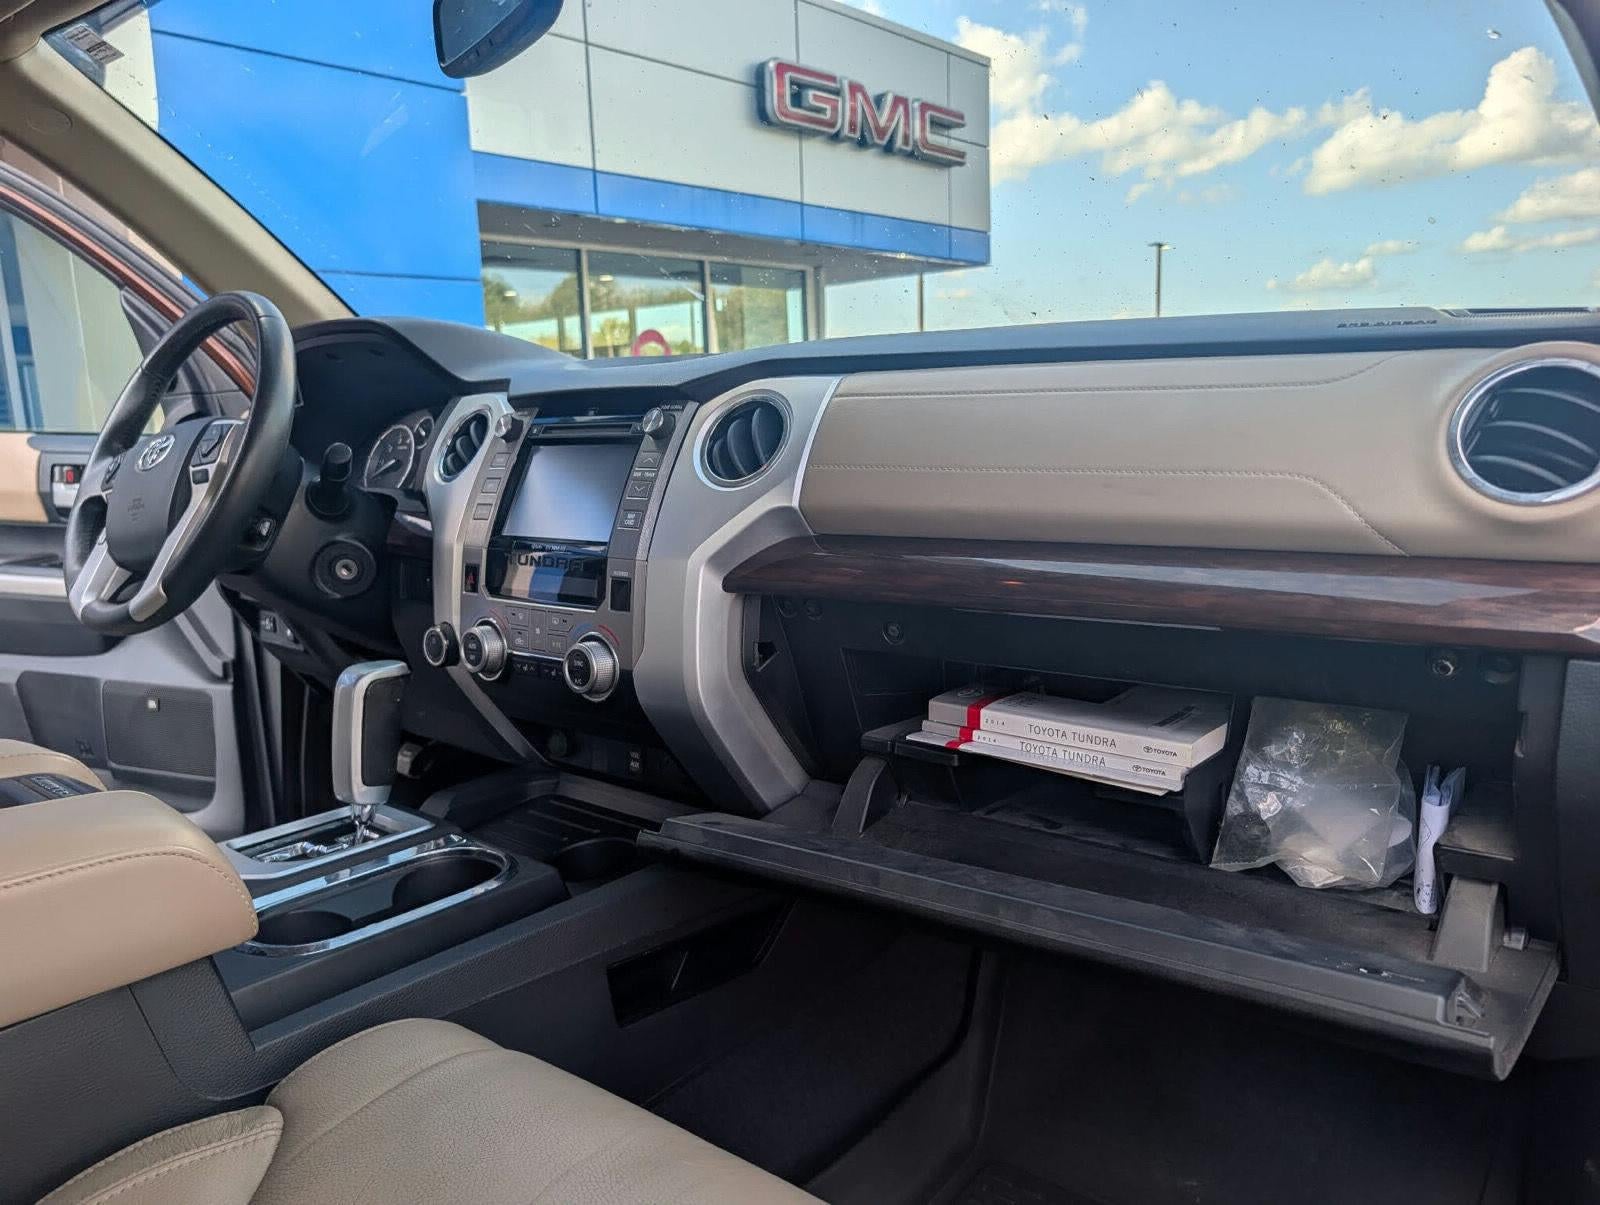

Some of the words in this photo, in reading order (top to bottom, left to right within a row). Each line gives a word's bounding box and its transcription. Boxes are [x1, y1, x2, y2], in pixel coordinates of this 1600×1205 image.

[764, 59, 967, 165] GMC
[1027, 723, 1068, 740] TOYOTA
[1072, 731, 1117, 749] TUNDRA
[1152, 748, 1178, 758] TOYOTA
[1019, 741, 1058, 758] TOYOTA
[1062, 749, 1106, 767] TUNDRA
[1142, 766, 1166, 777] TOYOTA
